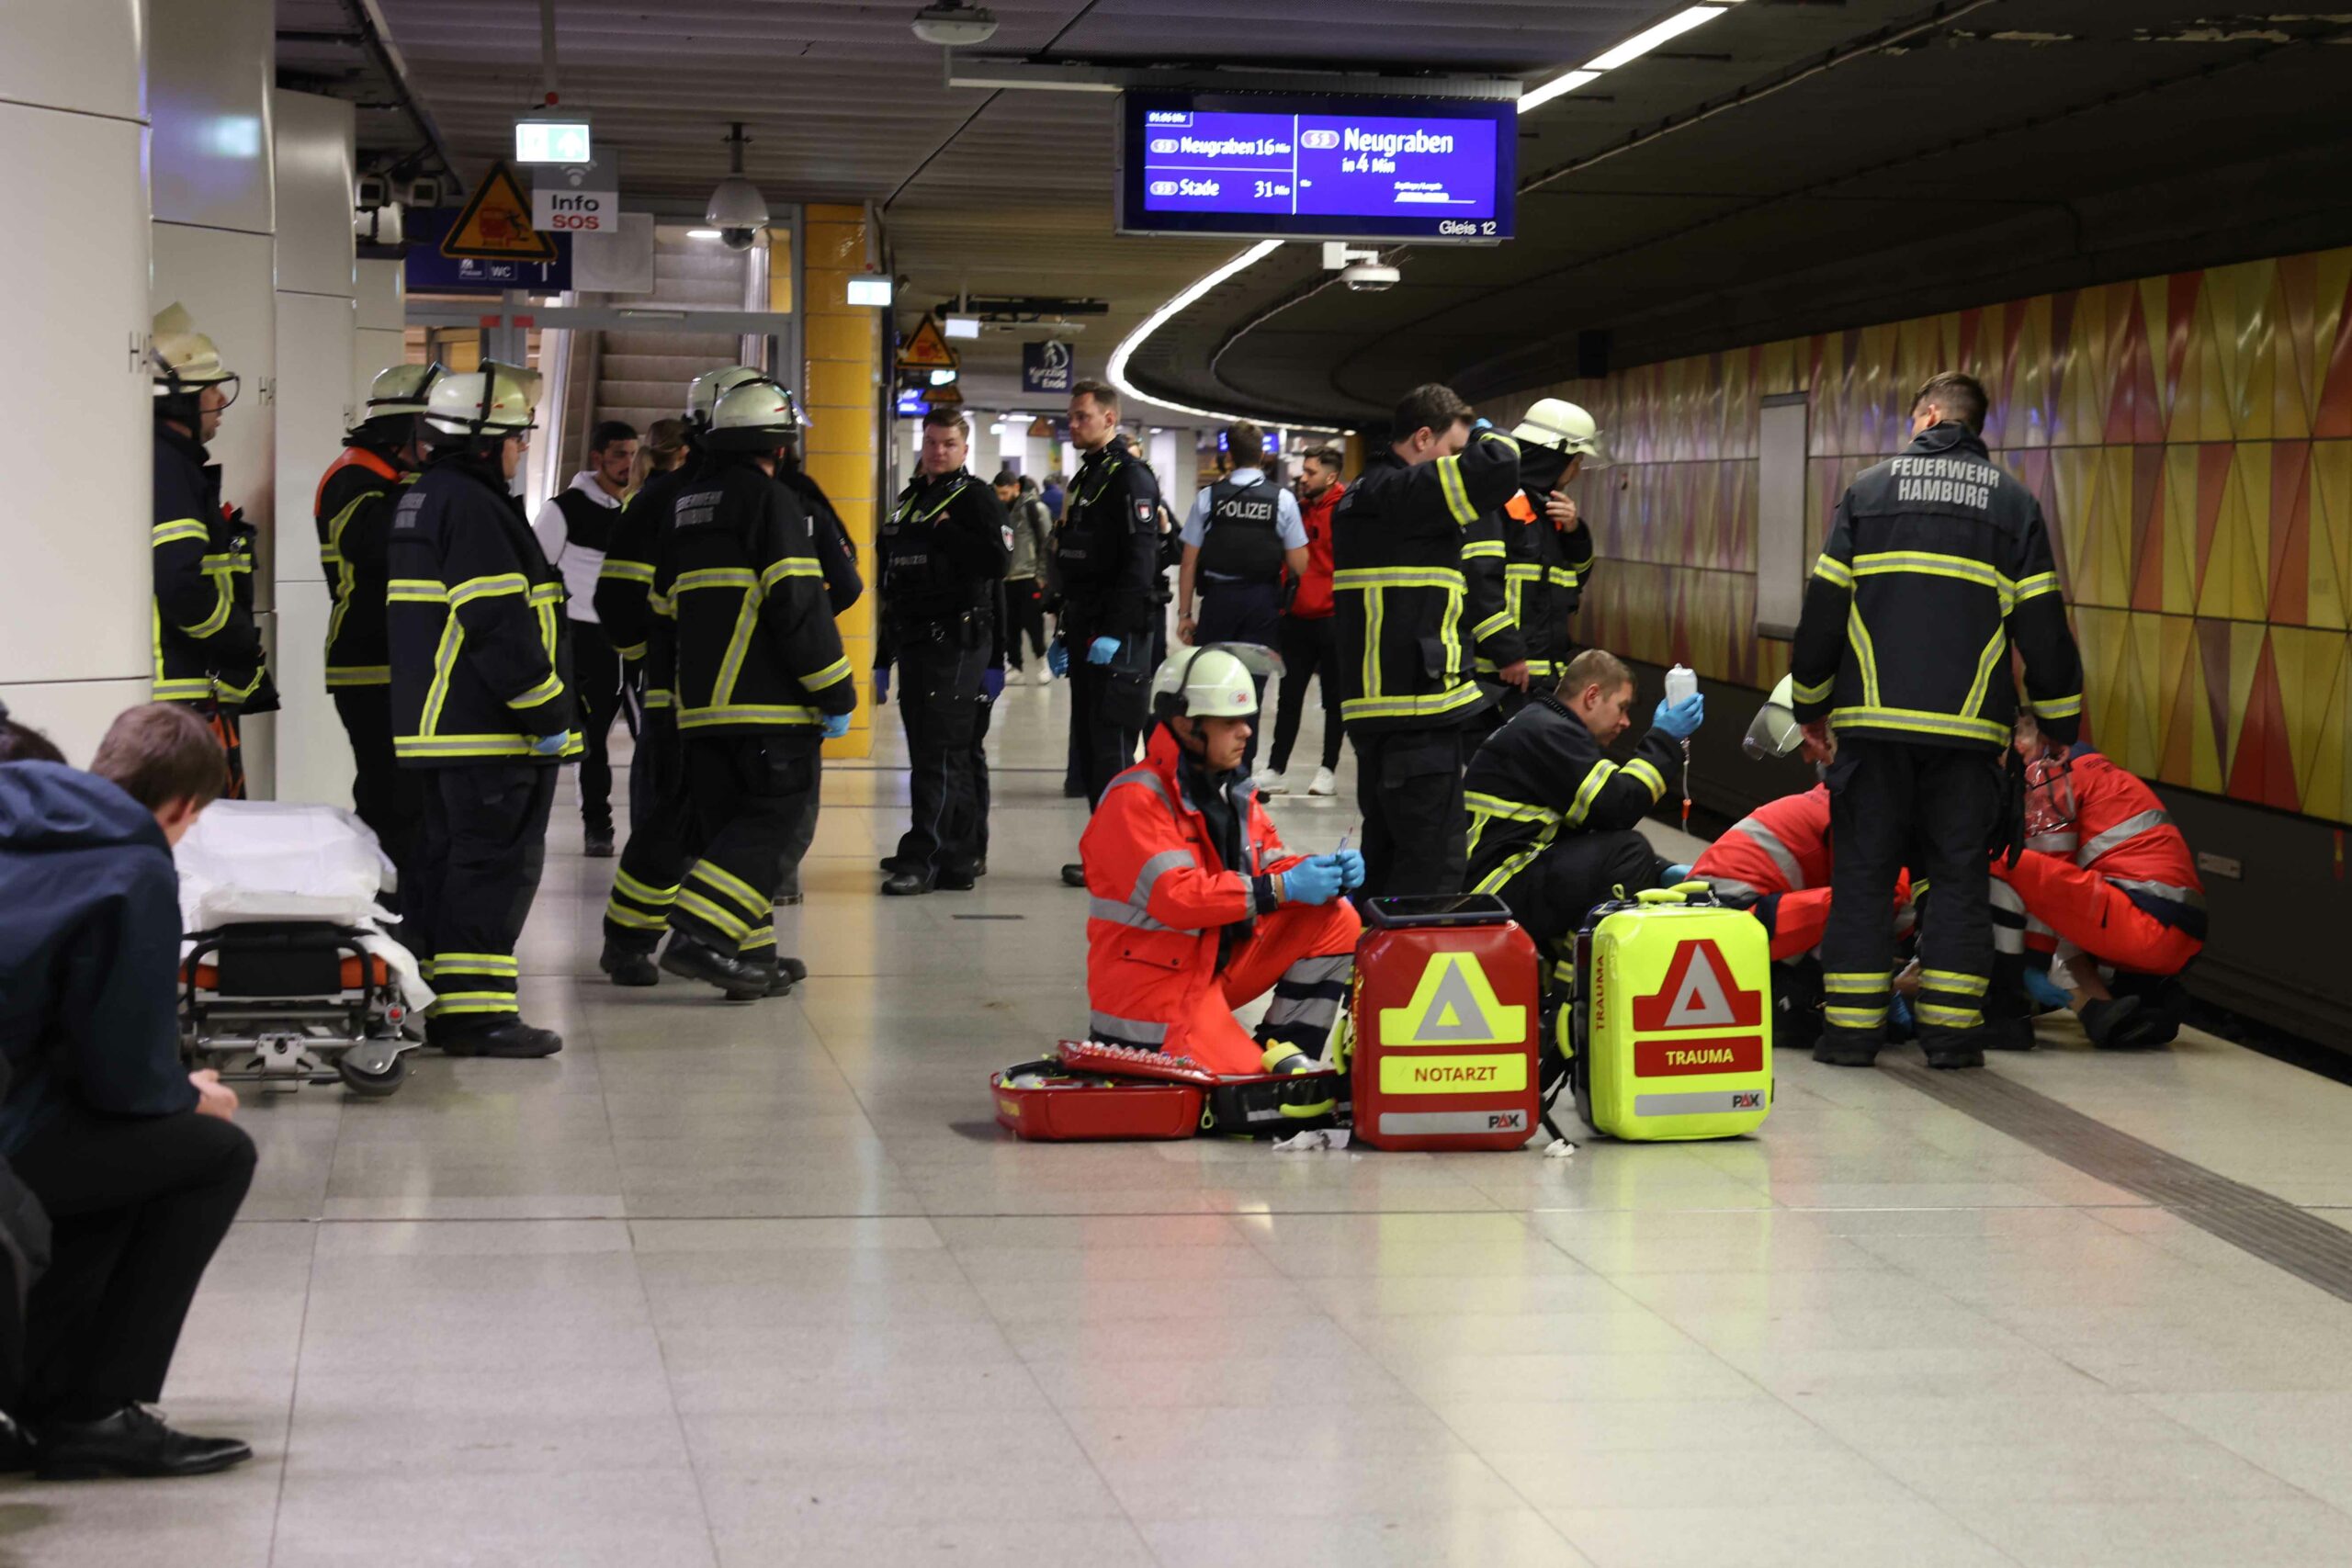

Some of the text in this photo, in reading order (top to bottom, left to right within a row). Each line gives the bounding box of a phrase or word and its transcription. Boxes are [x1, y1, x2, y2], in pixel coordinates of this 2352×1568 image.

[1181, 136, 1255, 158] Neugraben
[1256, 139, 1274, 155] 16
[1344, 128, 1453, 157] Neugraben
[1341, 152, 1396, 174] in 4 Min
[1180, 178, 1219, 196] Stade
[1254, 181, 1272, 197] 31
[552, 195, 600, 211] Info
[552, 214, 600, 230] SOS
[1439, 220, 1497, 235] Gleis 12
[492, 266, 511, 277] WC
[1042, 378, 1067, 389] Ende
[1890, 457, 2000, 488] FEUERWEHR
[1897, 479, 1989, 509] HAMBURG
[1595, 954, 1605, 1032] TRAUMA
[1666, 1048, 1735, 1066] TRAUMA
[1414, 1066, 1498, 1082] NOTARZT
[1732, 1093, 1760, 1108] PAX
[1488, 1113, 1520, 1129] PAX
